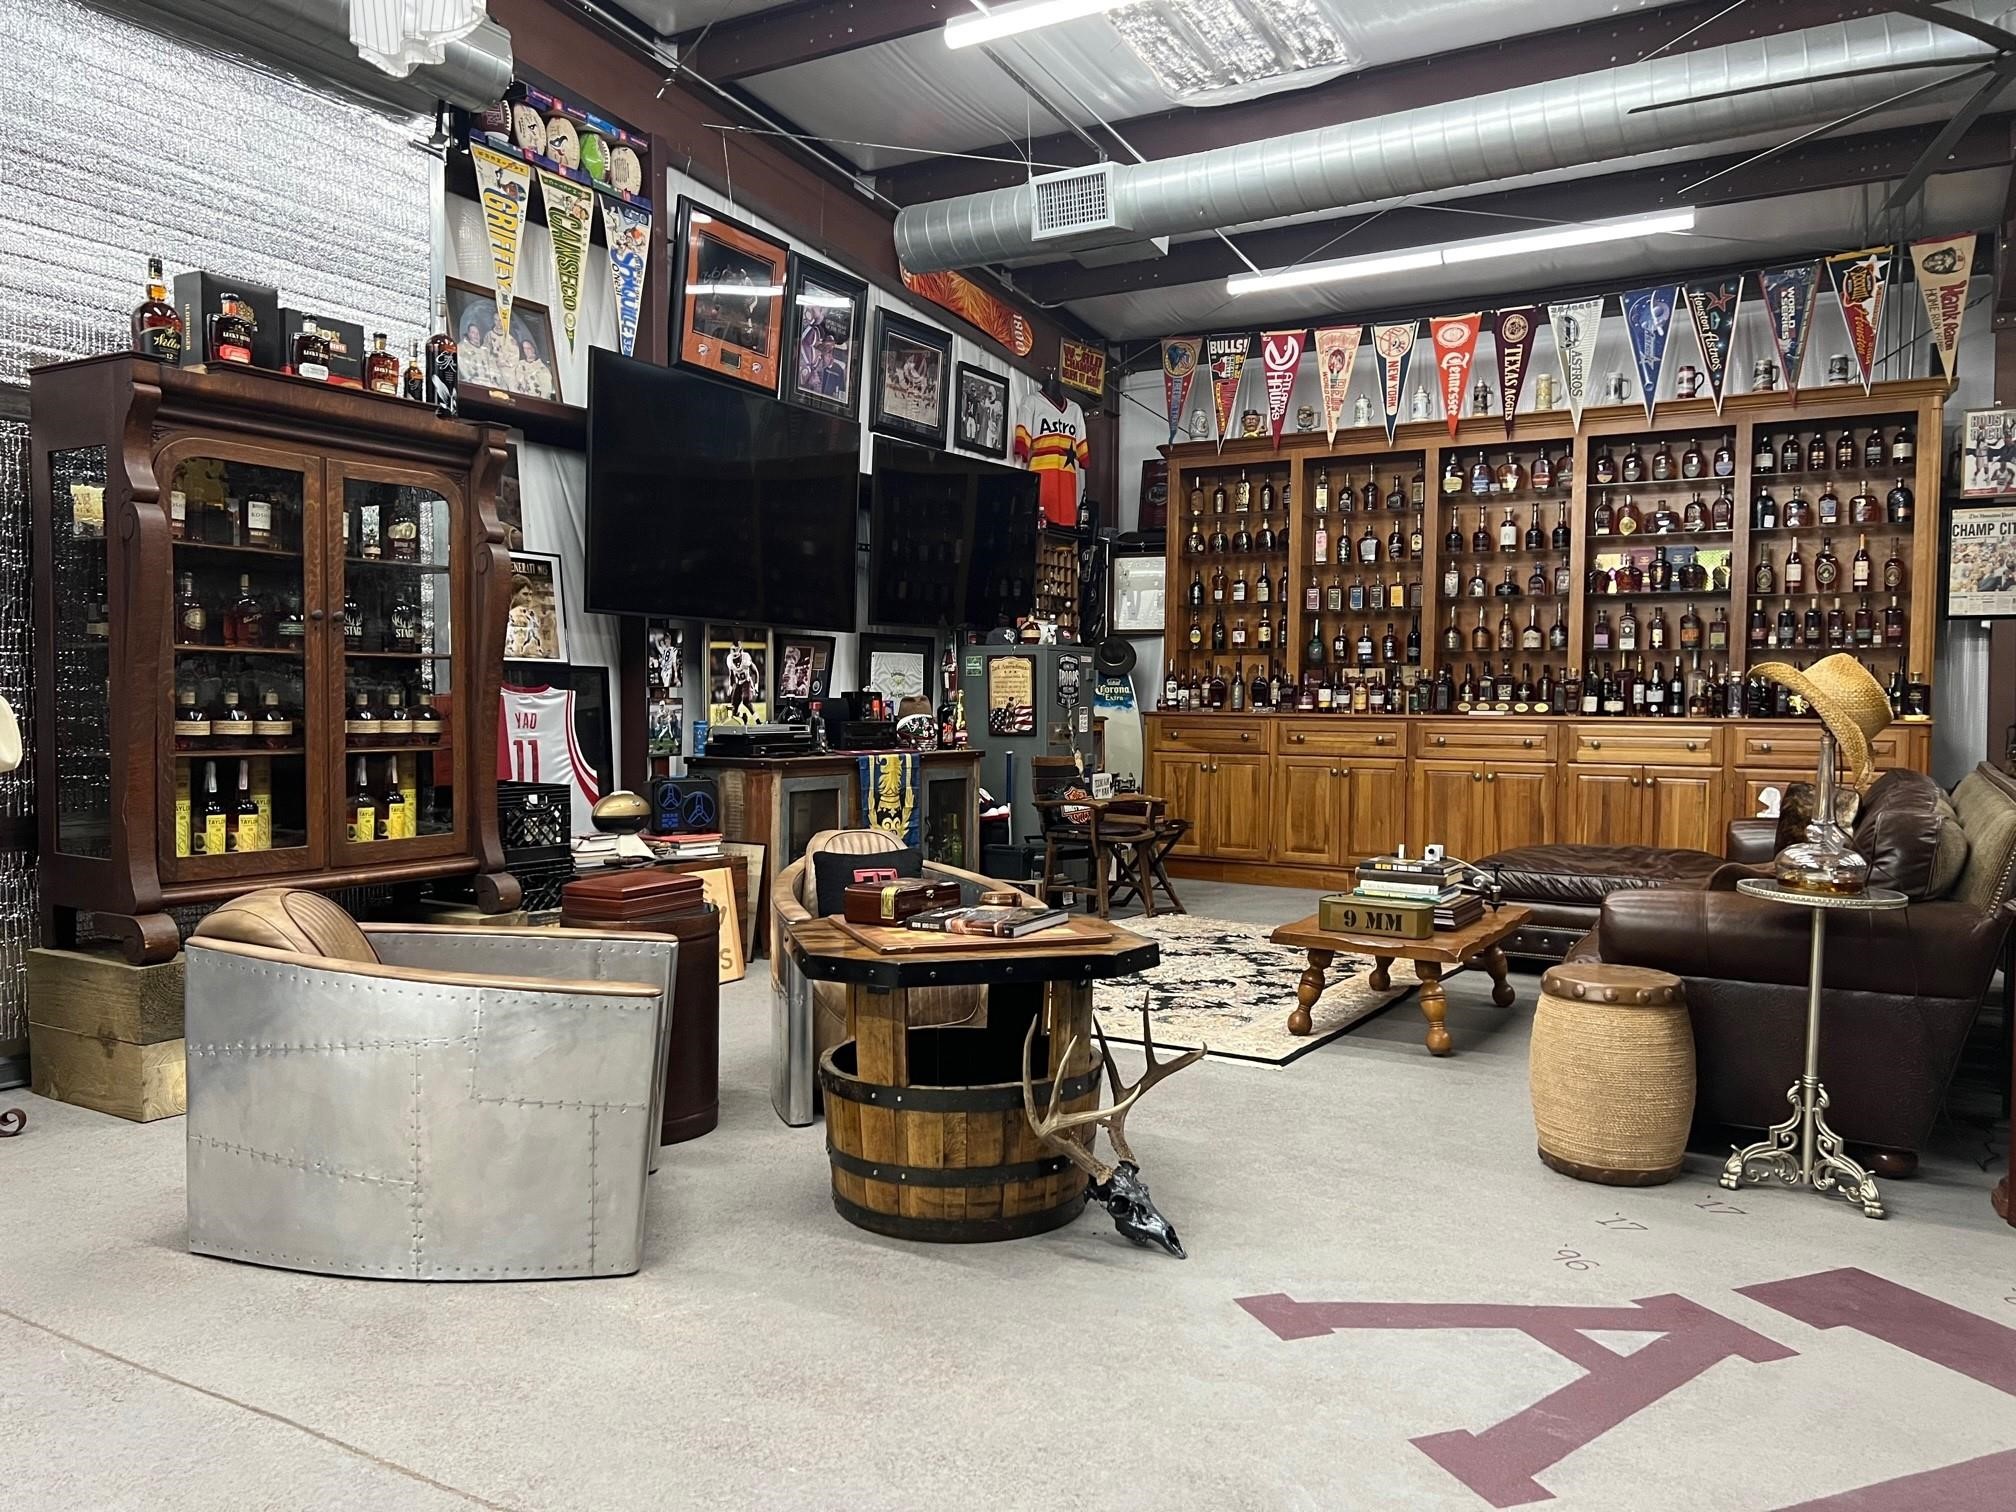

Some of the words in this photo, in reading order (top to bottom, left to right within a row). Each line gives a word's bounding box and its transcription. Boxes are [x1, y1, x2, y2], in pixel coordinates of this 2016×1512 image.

[483, 188, 520, 294] GRIFFEY
[548, 206, 583, 311] CANSECO
[1781, 297, 1790, 339] SERIES
[1786, 286, 1796, 328] WORLD
[1924, 288, 1938, 312] HOME
[1931, 313, 1942, 331] RUN
[1940, 280, 1967, 322] Hank
[622, 338, 633, 352] 32
[1012, 313, 1026, 352] 1800
[1209, 338, 1248, 354] BULLS!
[1689, 291, 1711, 332] Houston
[1703, 331, 1722, 371] Astros
[1854, 307, 1869, 355] Houston
[1943, 322, 1960, 351] Aaron
[1387, 360, 1399, 382] NEW
[1440, 352, 1470, 416] Tennessee
[1504, 344, 1523, 387] TEXAS
[1571, 350, 1583, 398] ASTROS
[1267, 371, 1283, 420] HAWKS
[1279, 372, 1293, 415] ATLANTA
[1386, 383, 1398, 408] YORK
[1504, 387, 1515, 421] AGGIES
[1040, 417, 1077, 436] Astro
[1952, 523, 1995, 537] CHAMP
[2000, 522, 2016, 535] CIT
[1058, 668, 1080, 688] TROOPS
[1095, 684, 1131, 697] Corona
[1105, 693, 1124, 701] Extra
[514, 712, 538, 730] YAO
[513, 739, 541, 783] 11
[1343, 910, 1357, 927] 9
[1365, 911, 1403, 932] MM
